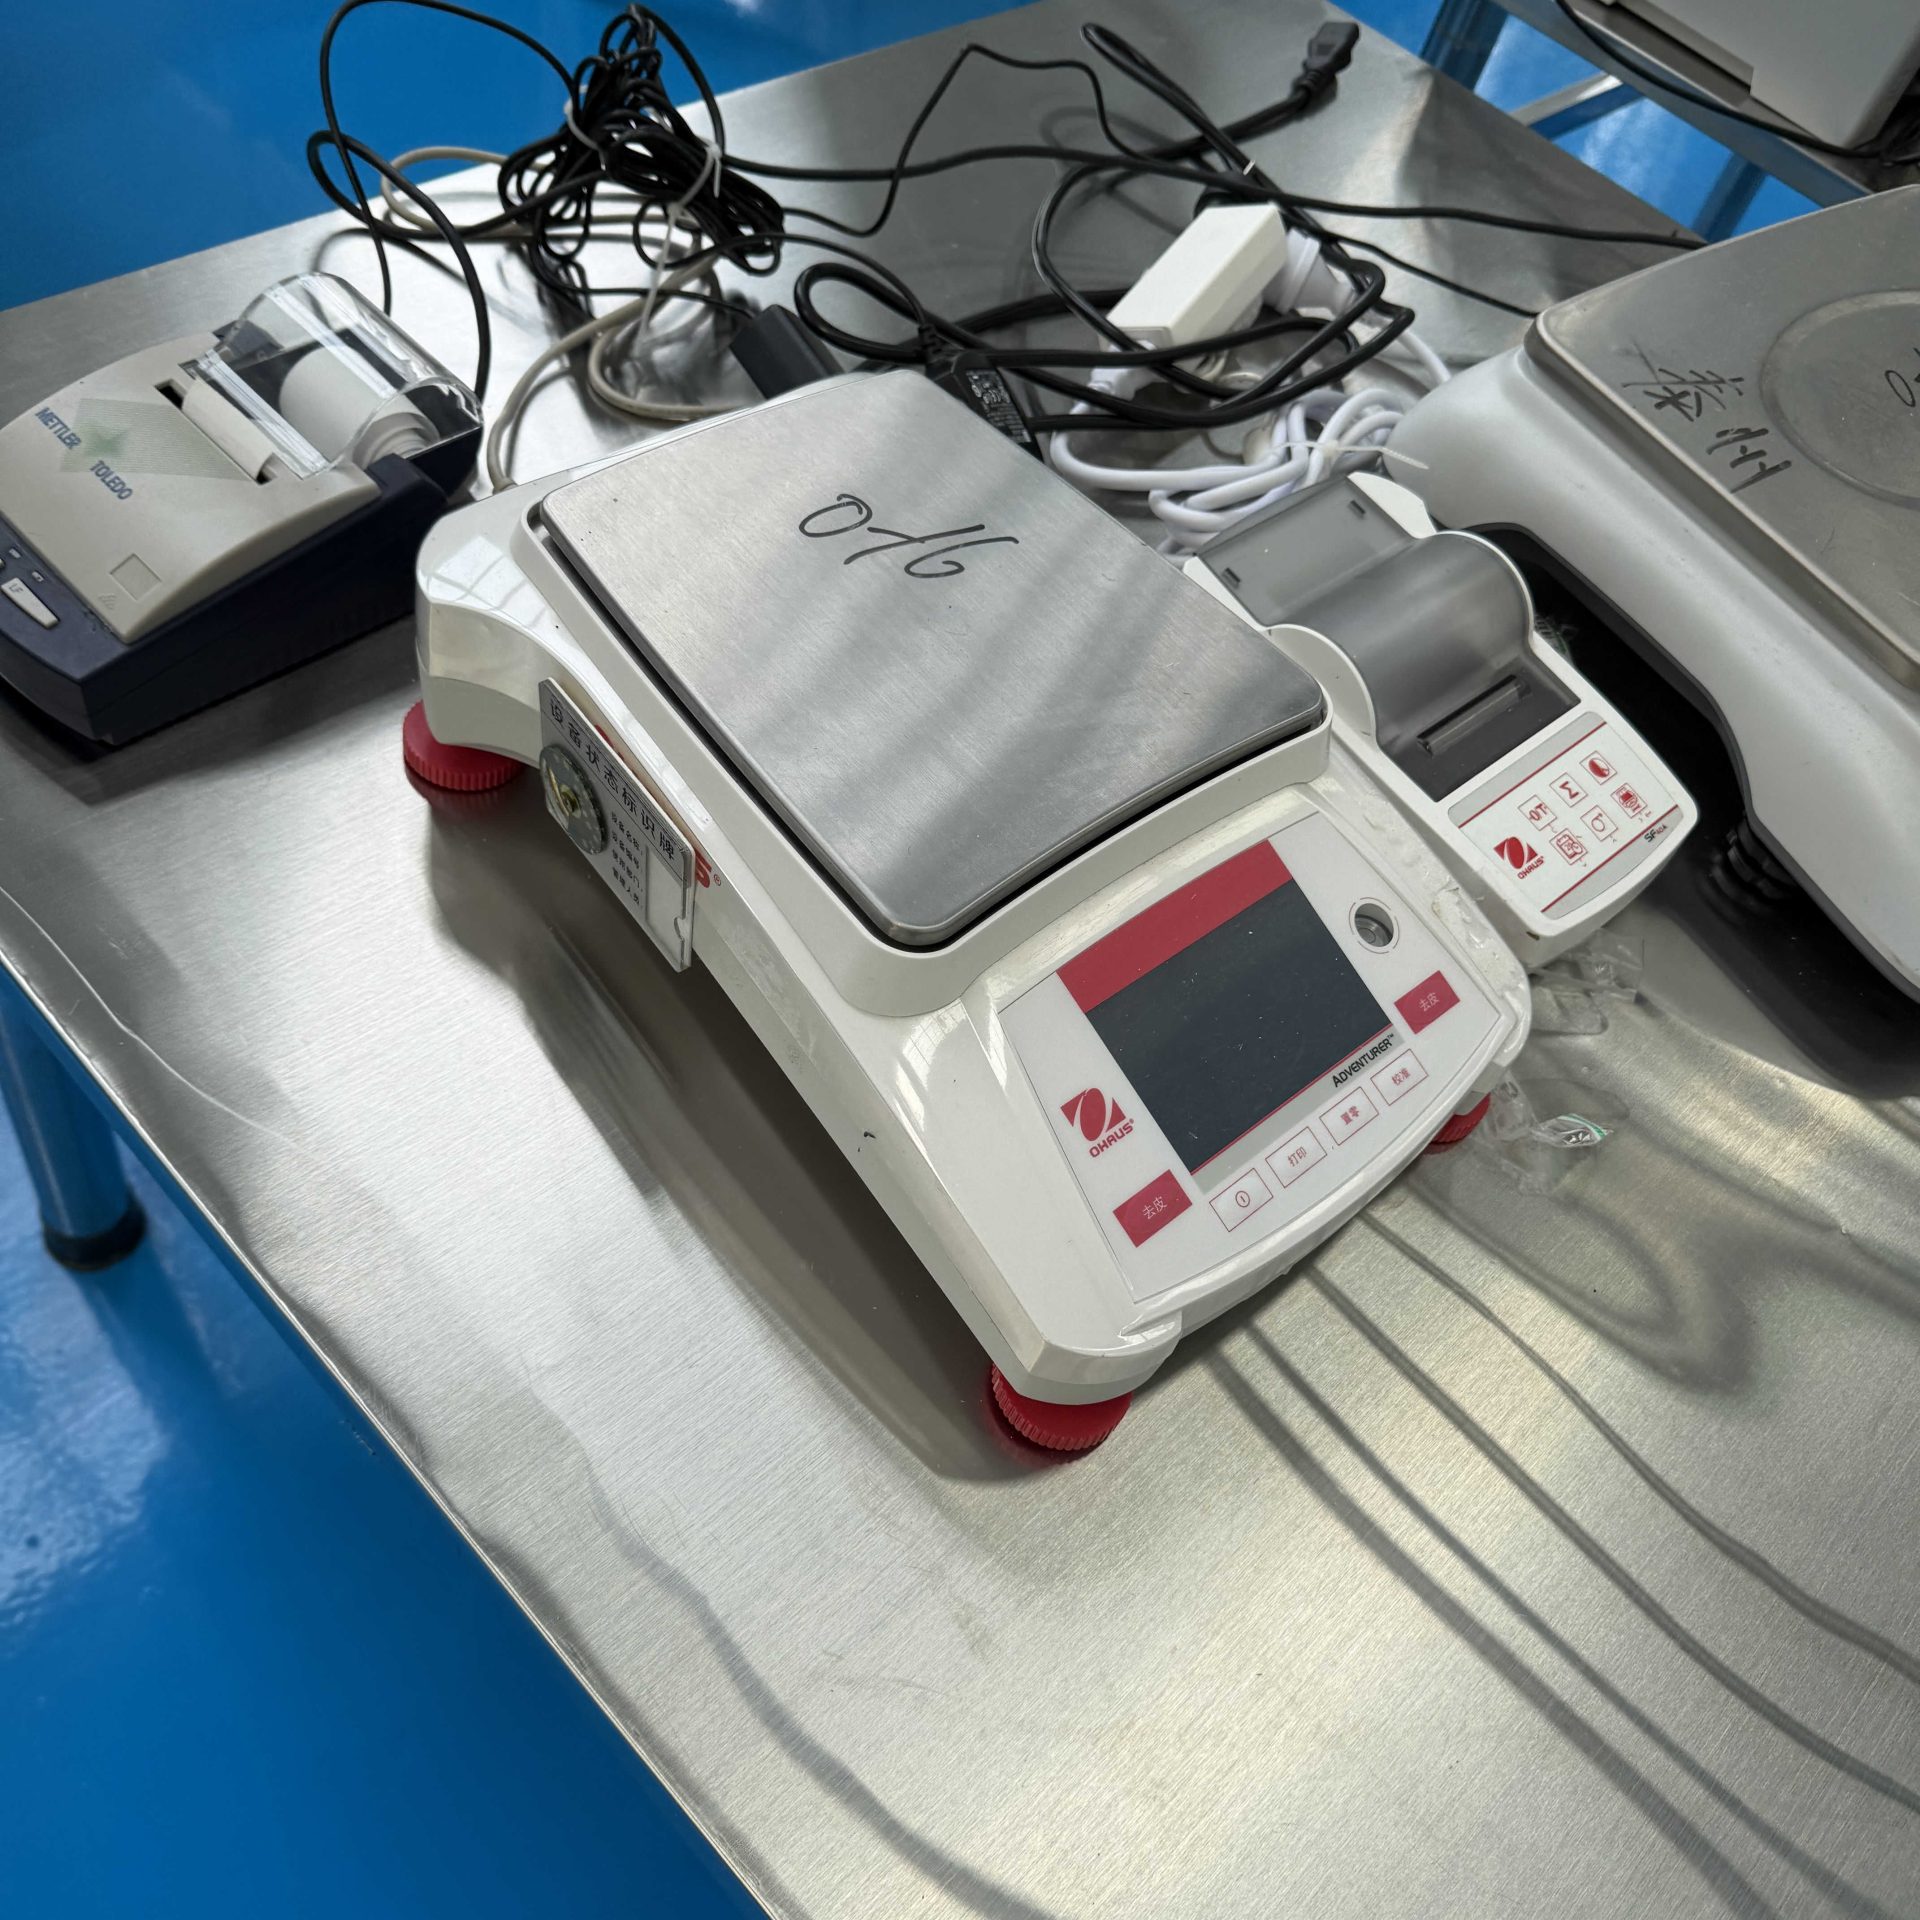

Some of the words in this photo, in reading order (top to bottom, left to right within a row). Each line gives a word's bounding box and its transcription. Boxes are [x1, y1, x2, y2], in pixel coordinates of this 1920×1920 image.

[35, 407, 82, 450] METTLER
[89, 459, 133, 500] TOLEDO
[550, 698, 676, 861] 设备状态标识牌
[1418, 993, 1438, 1011] 去皮
[1391, 1067, 1411, 1086] 校准
[1340, 1105, 1360, 1126] 置零
[1287, 1145, 1308, 1168] 打印
[1142, 1195, 1169, 1219] 去皮
